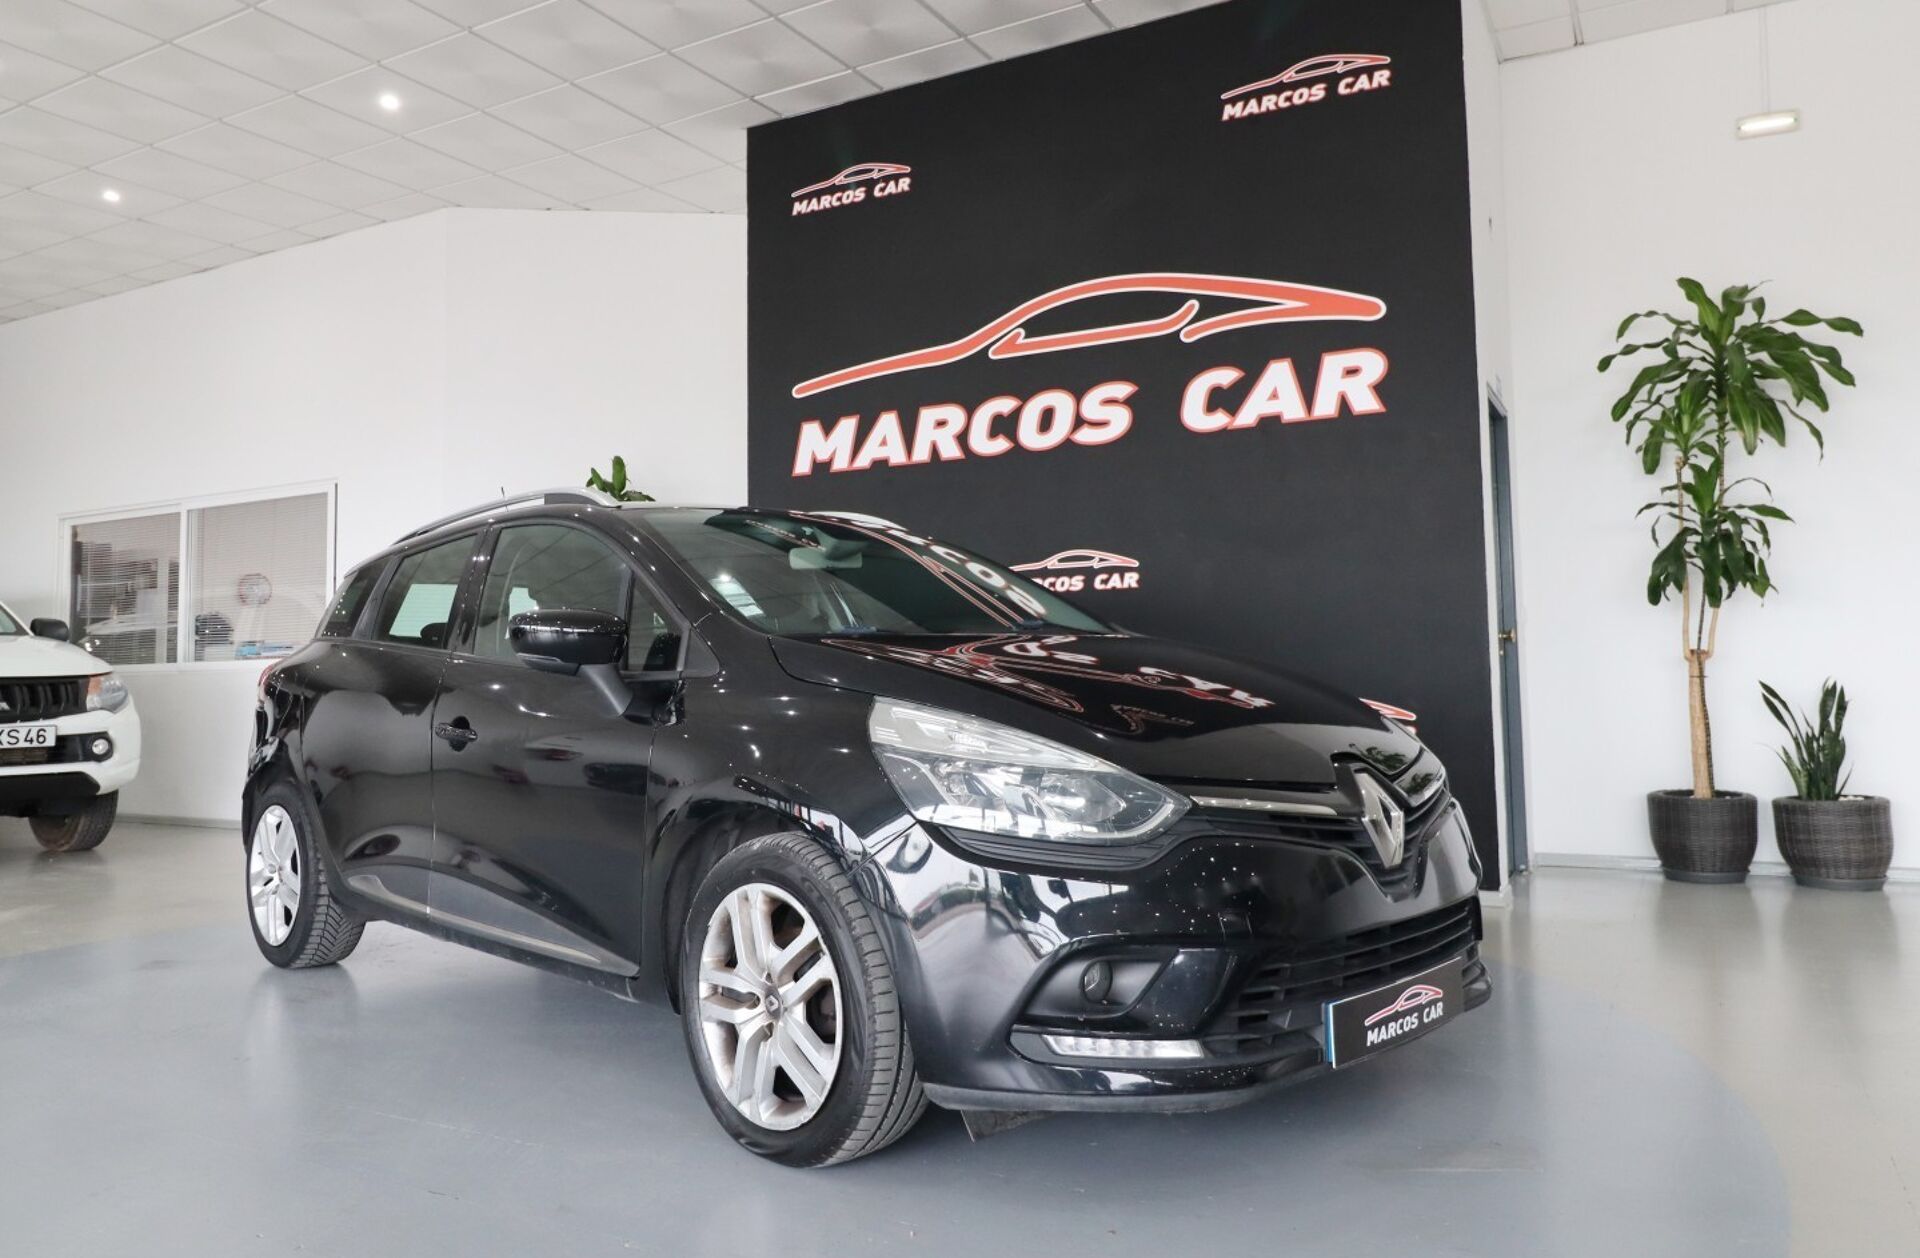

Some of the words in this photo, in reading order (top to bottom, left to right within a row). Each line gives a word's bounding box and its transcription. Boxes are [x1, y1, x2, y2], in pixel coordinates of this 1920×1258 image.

[1221, 83, 1328, 121] MARCOS
[1337, 69, 1391, 96] CAR
[792, 186, 867, 216] MARCOS
[873, 177, 911, 197] CAR
[791, 380, 1139, 478] MARCOS
[1180, 347, 1389, 434] CAR
[1093, 571, 1140, 590] CAR
[1366, 1012, 1419, 1047] MARCOS
[1423, 1001, 1444, 1023] CAR
